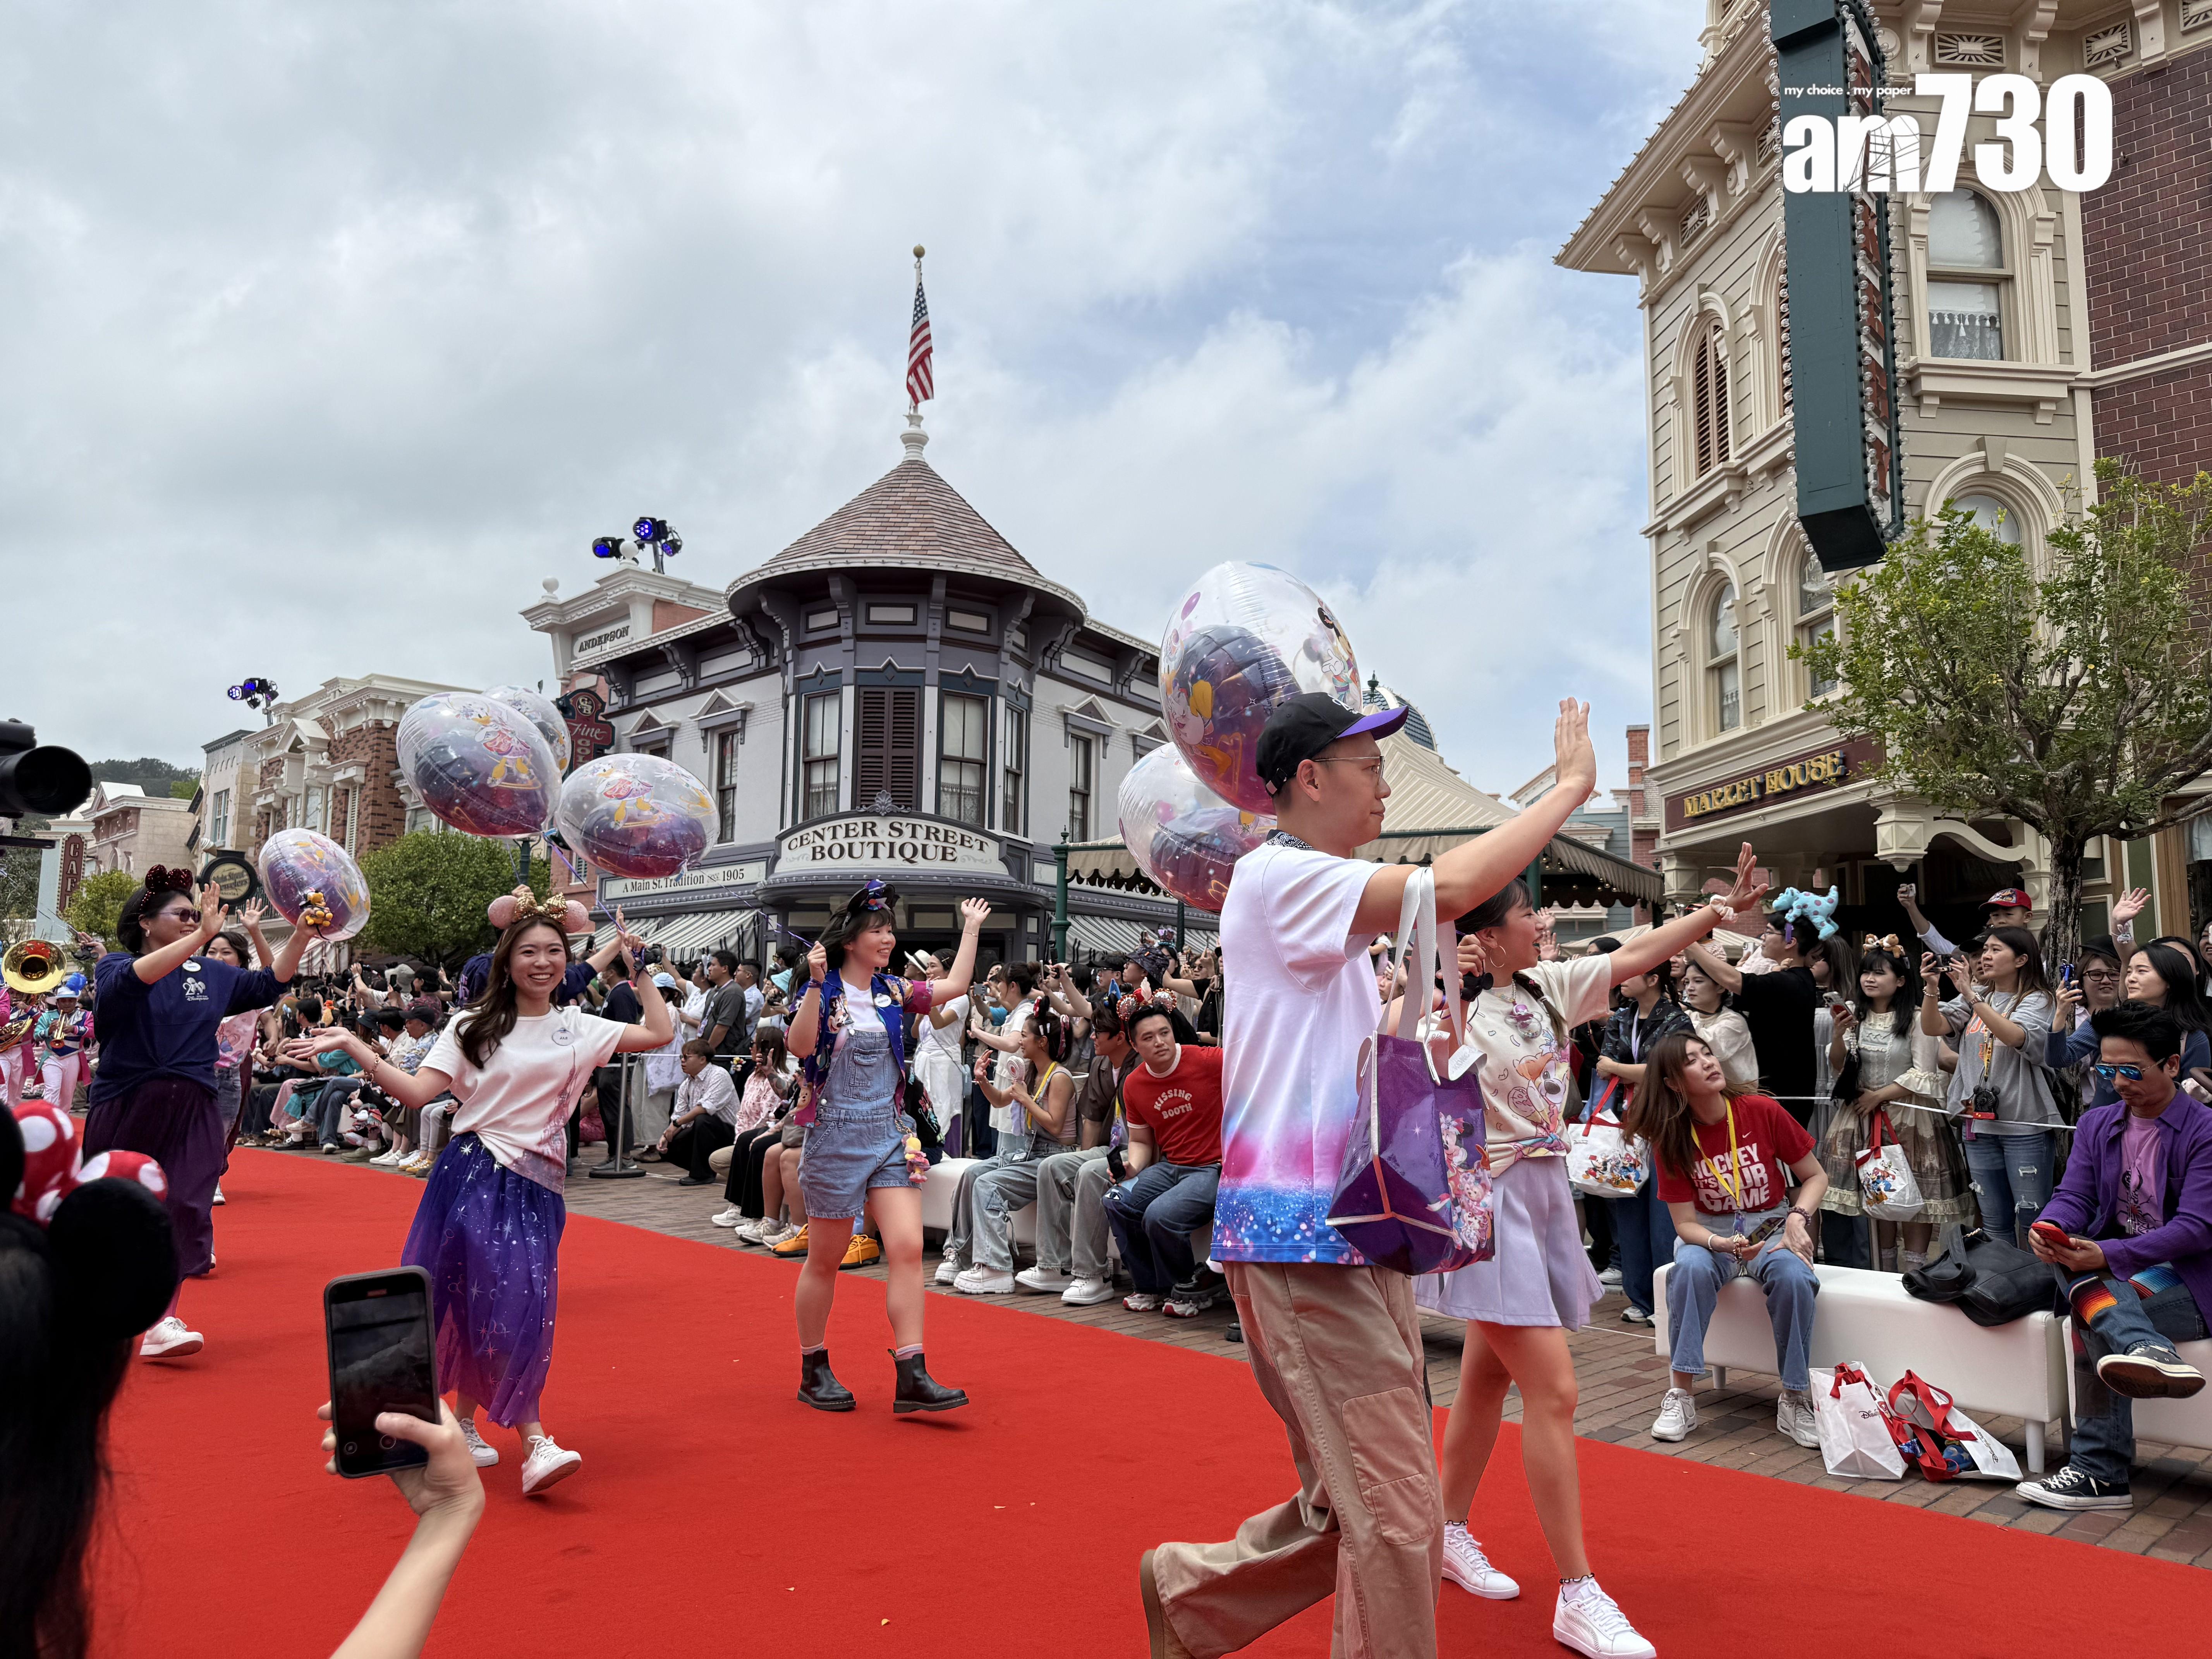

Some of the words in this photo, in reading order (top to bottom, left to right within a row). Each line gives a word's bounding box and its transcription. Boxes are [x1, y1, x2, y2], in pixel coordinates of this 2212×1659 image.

[579, 625, 630, 652] ANDERSON
[567, 722, 608, 740] Fine
[577, 738, 591, 768] GOL
[1684, 775, 1764, 817] MARKET
[1765, 750, 1846, 794] HOUSE
[788, 821, 879, 850] CENTER
[888, 821, 989, 852] STREET
[811, 841, 958, 864] BOUTIQUE
[623, 883, 629, 893] A
[630, 879, 650, 892] Main
[653, 878, 663, 890] St.
[723, 869, 744, 881] 1905
[1154, 1089, 1192, 1111] KISSING
[1161, 1103, 1193, 1119] BOOTH
[1691, 1143, 1760, 1179] HOCKEY
[1718, 1163, 1769, 1197] OUR
[1698, 1184, 1770, 1212] GAME
